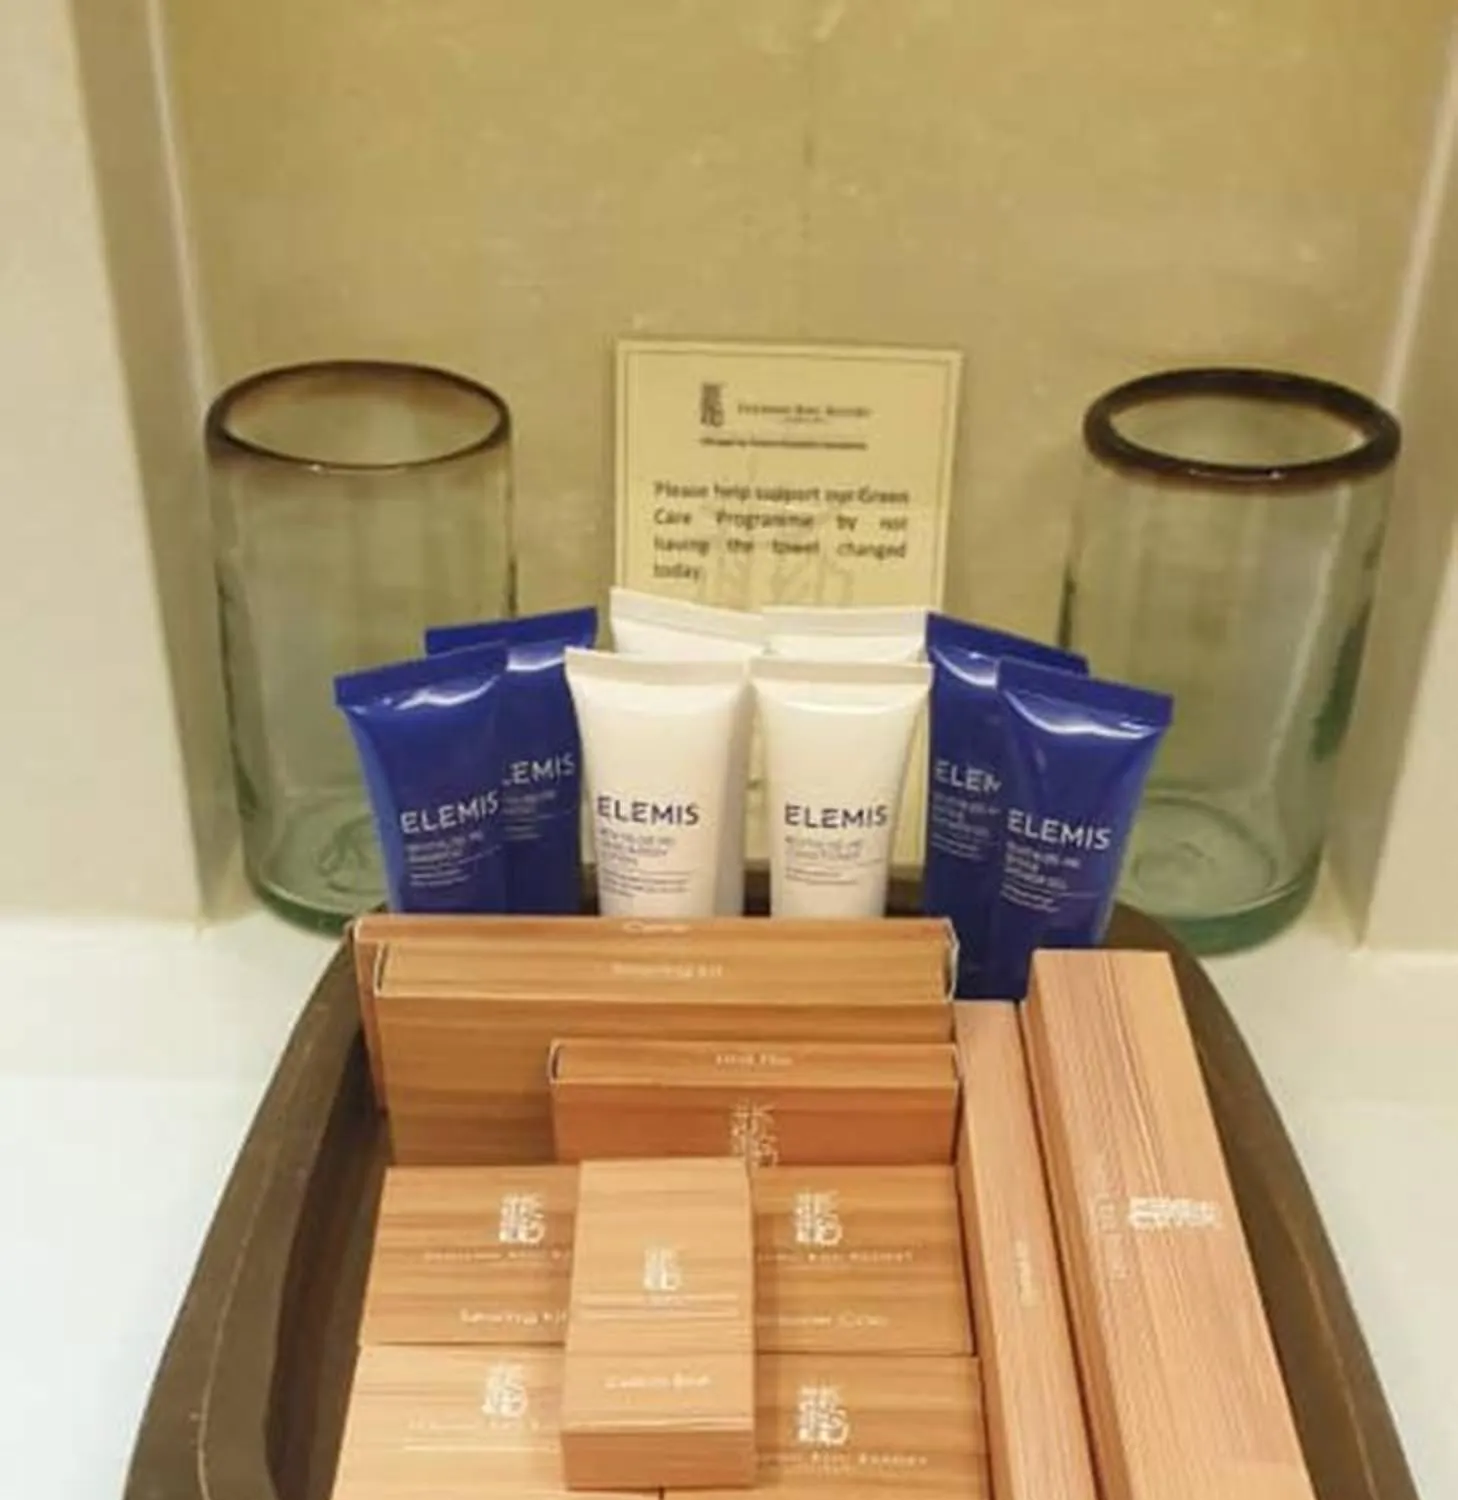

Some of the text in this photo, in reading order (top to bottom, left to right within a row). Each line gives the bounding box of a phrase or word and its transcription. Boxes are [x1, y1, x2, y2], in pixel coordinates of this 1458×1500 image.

[654, 481, 709, 498] Please
[714, 483, 751, 504] help
[756, 486, 820, 504] support
[858, 486, 909, 503] Green
[653, 507, 692, 525] Care
[716, 510, 814, 531] Programme
[837, 514, 858, 532] by
[654, 535, 907, 561] having the towel changed
[502, 752, 575, 786] EMIS
[935, 760, 1002, 793] ELEM
[400, 790, 499, 834] ELEMIS
[597, 796, 700, 826] ELEMIS
[784, 804, 888, 829] ELEMIS
[1006, 807, 1112, 850] ELEMIS
